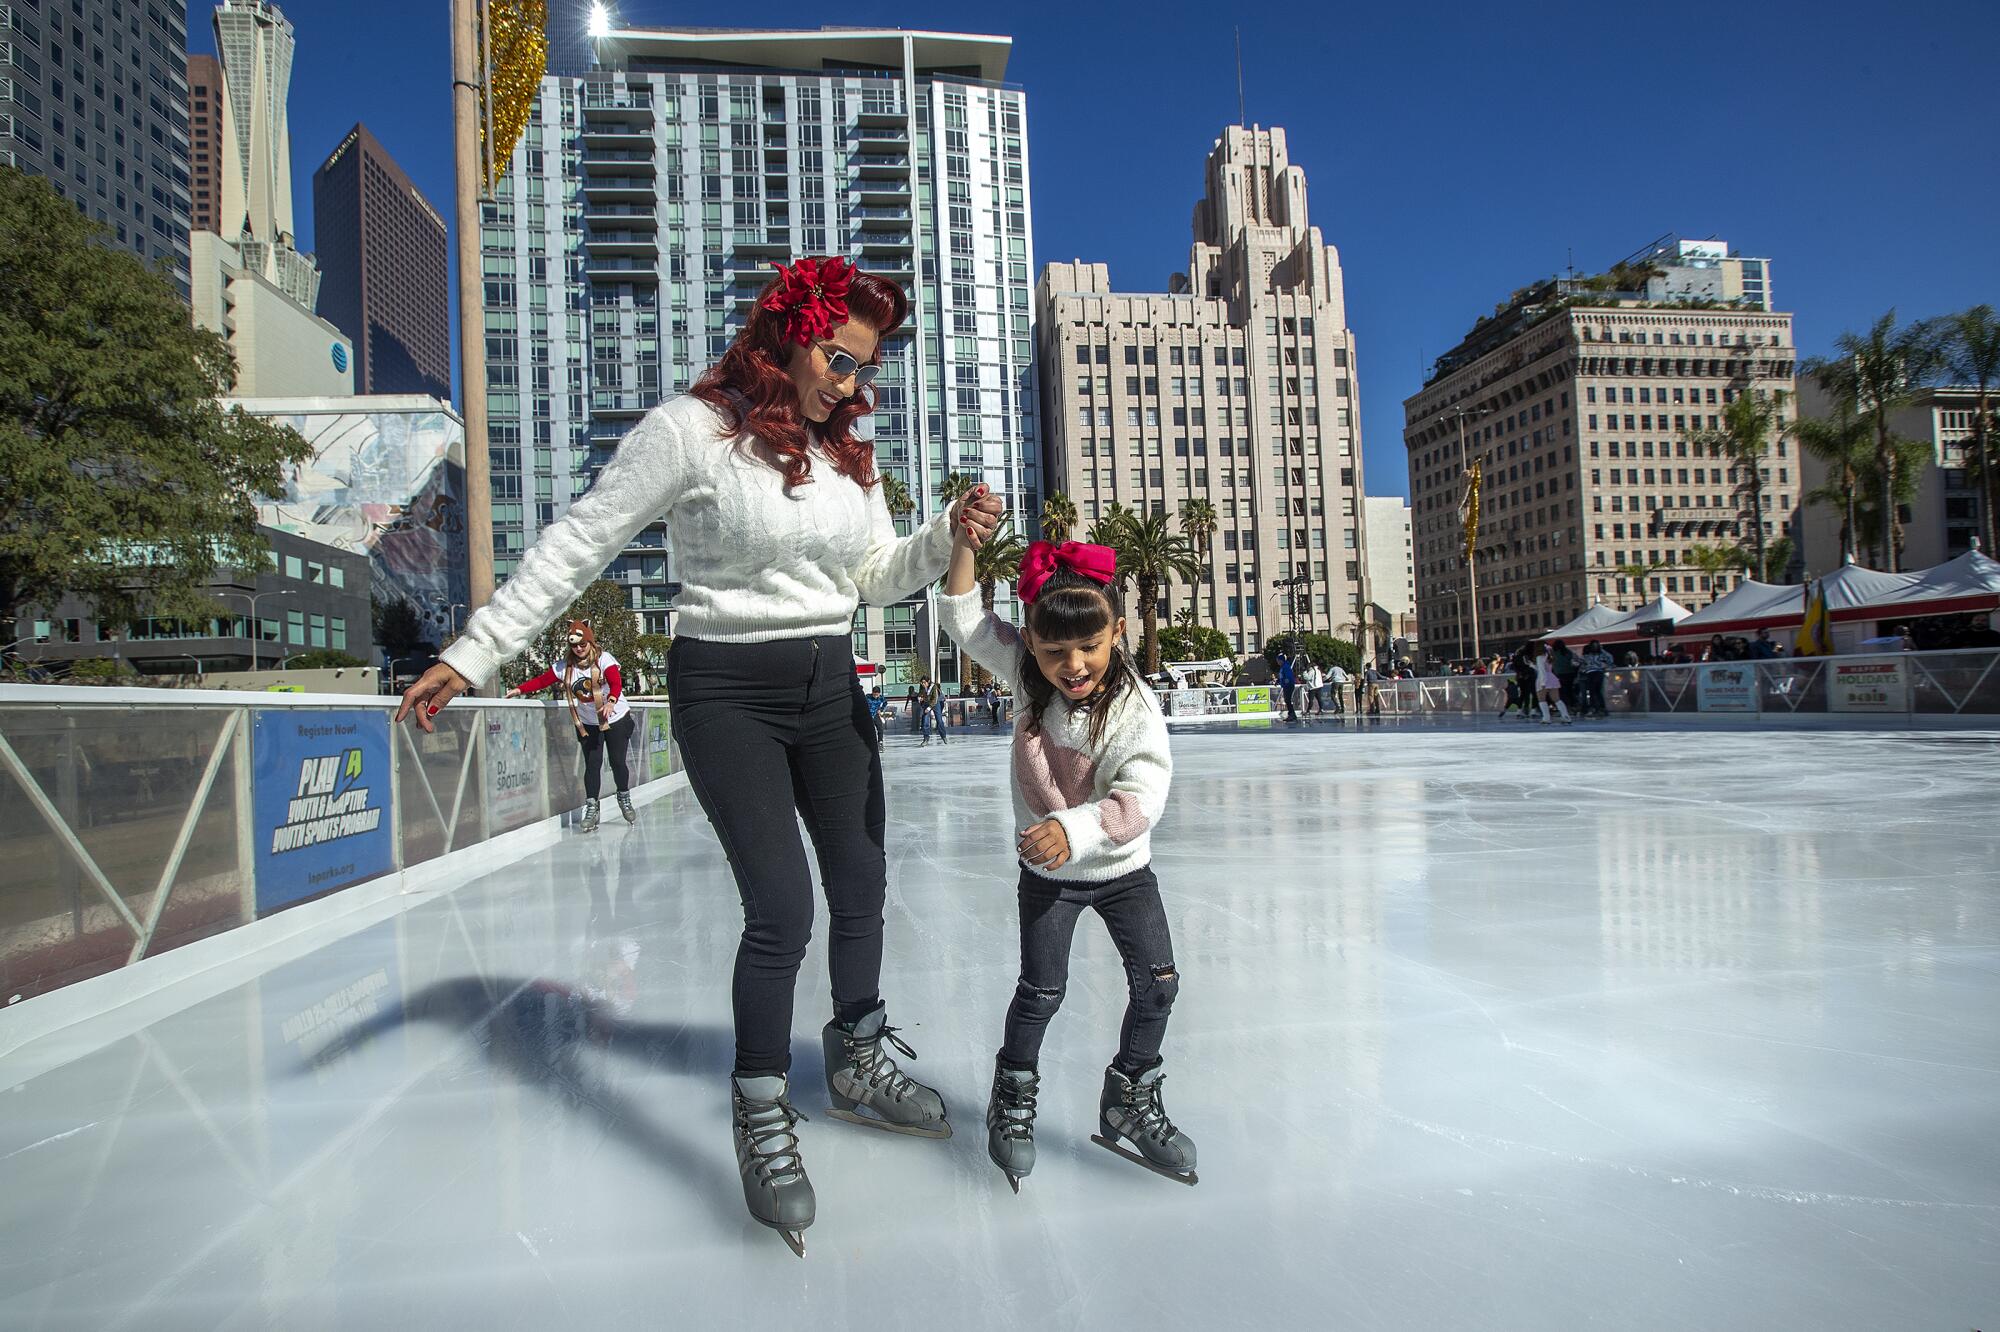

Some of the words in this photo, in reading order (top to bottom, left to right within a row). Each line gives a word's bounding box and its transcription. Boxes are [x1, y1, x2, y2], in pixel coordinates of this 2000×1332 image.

[1838, 674, 1899, 684] HOLIDAYS
[298, 725, 333, 739] Register
[335, 724, 357, 735] Now!
[298, 756, 340, 797] PLAY
[497, 761, 507, 775] DJ
[496, 771, 534, 791] SPOTLIGHT
[288, 797, 320, 824] YOUTH
[272, 824, 306, 853] YOUTH
[305, 817, 340, 846] SPORTS
[338, 808, 380, 838] PROGRAM
